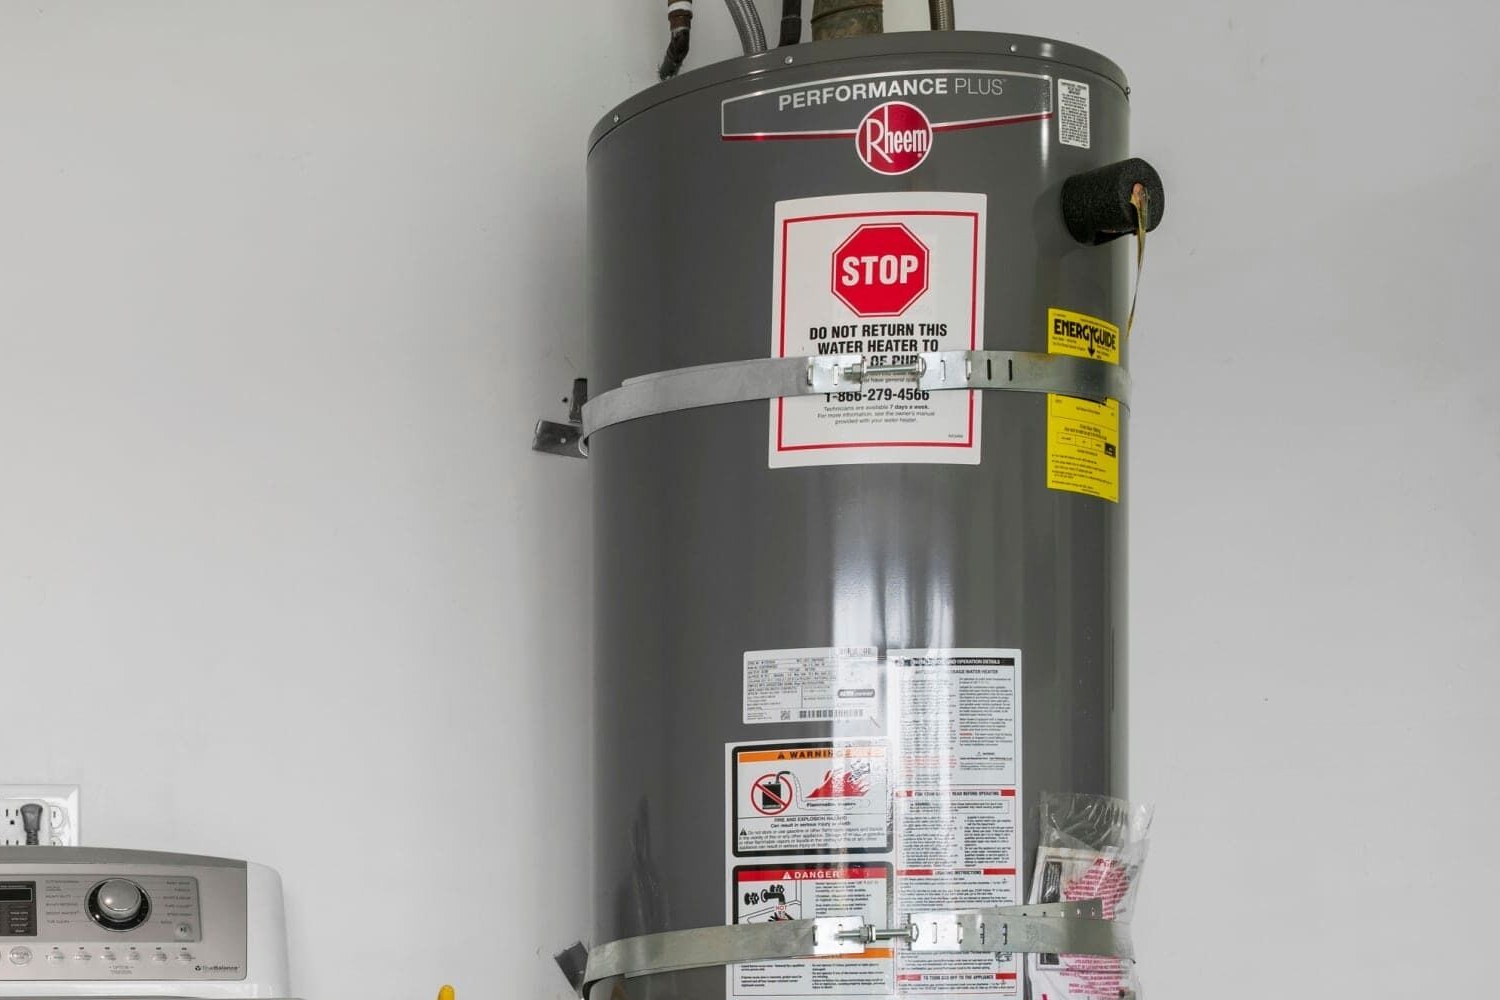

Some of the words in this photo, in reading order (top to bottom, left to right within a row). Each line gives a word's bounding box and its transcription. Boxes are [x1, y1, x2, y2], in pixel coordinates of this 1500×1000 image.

[779, 78, 947, 112] PERFORMANCE
[954, 78, 1003, 96] PLUS
[866, 105, 928, 163] Rheem
[841, 254, 919, 287] STOP
[810, 327, 827, 340] DO
[831, 325, 858, 338] NOT
[862, 324, 914, 337] RETURN
[919, 323, 947, 336] THIS
[818, 340, 863, 354] WATER
[868, 339, 917, 353] HEATER
[922, 339, 938, 352] TO
[824, 388, 930, 403] 1-866-279-4566
[790, 751, 843, 760] WARNIN
[794, 870, 841, 879] DANGER
